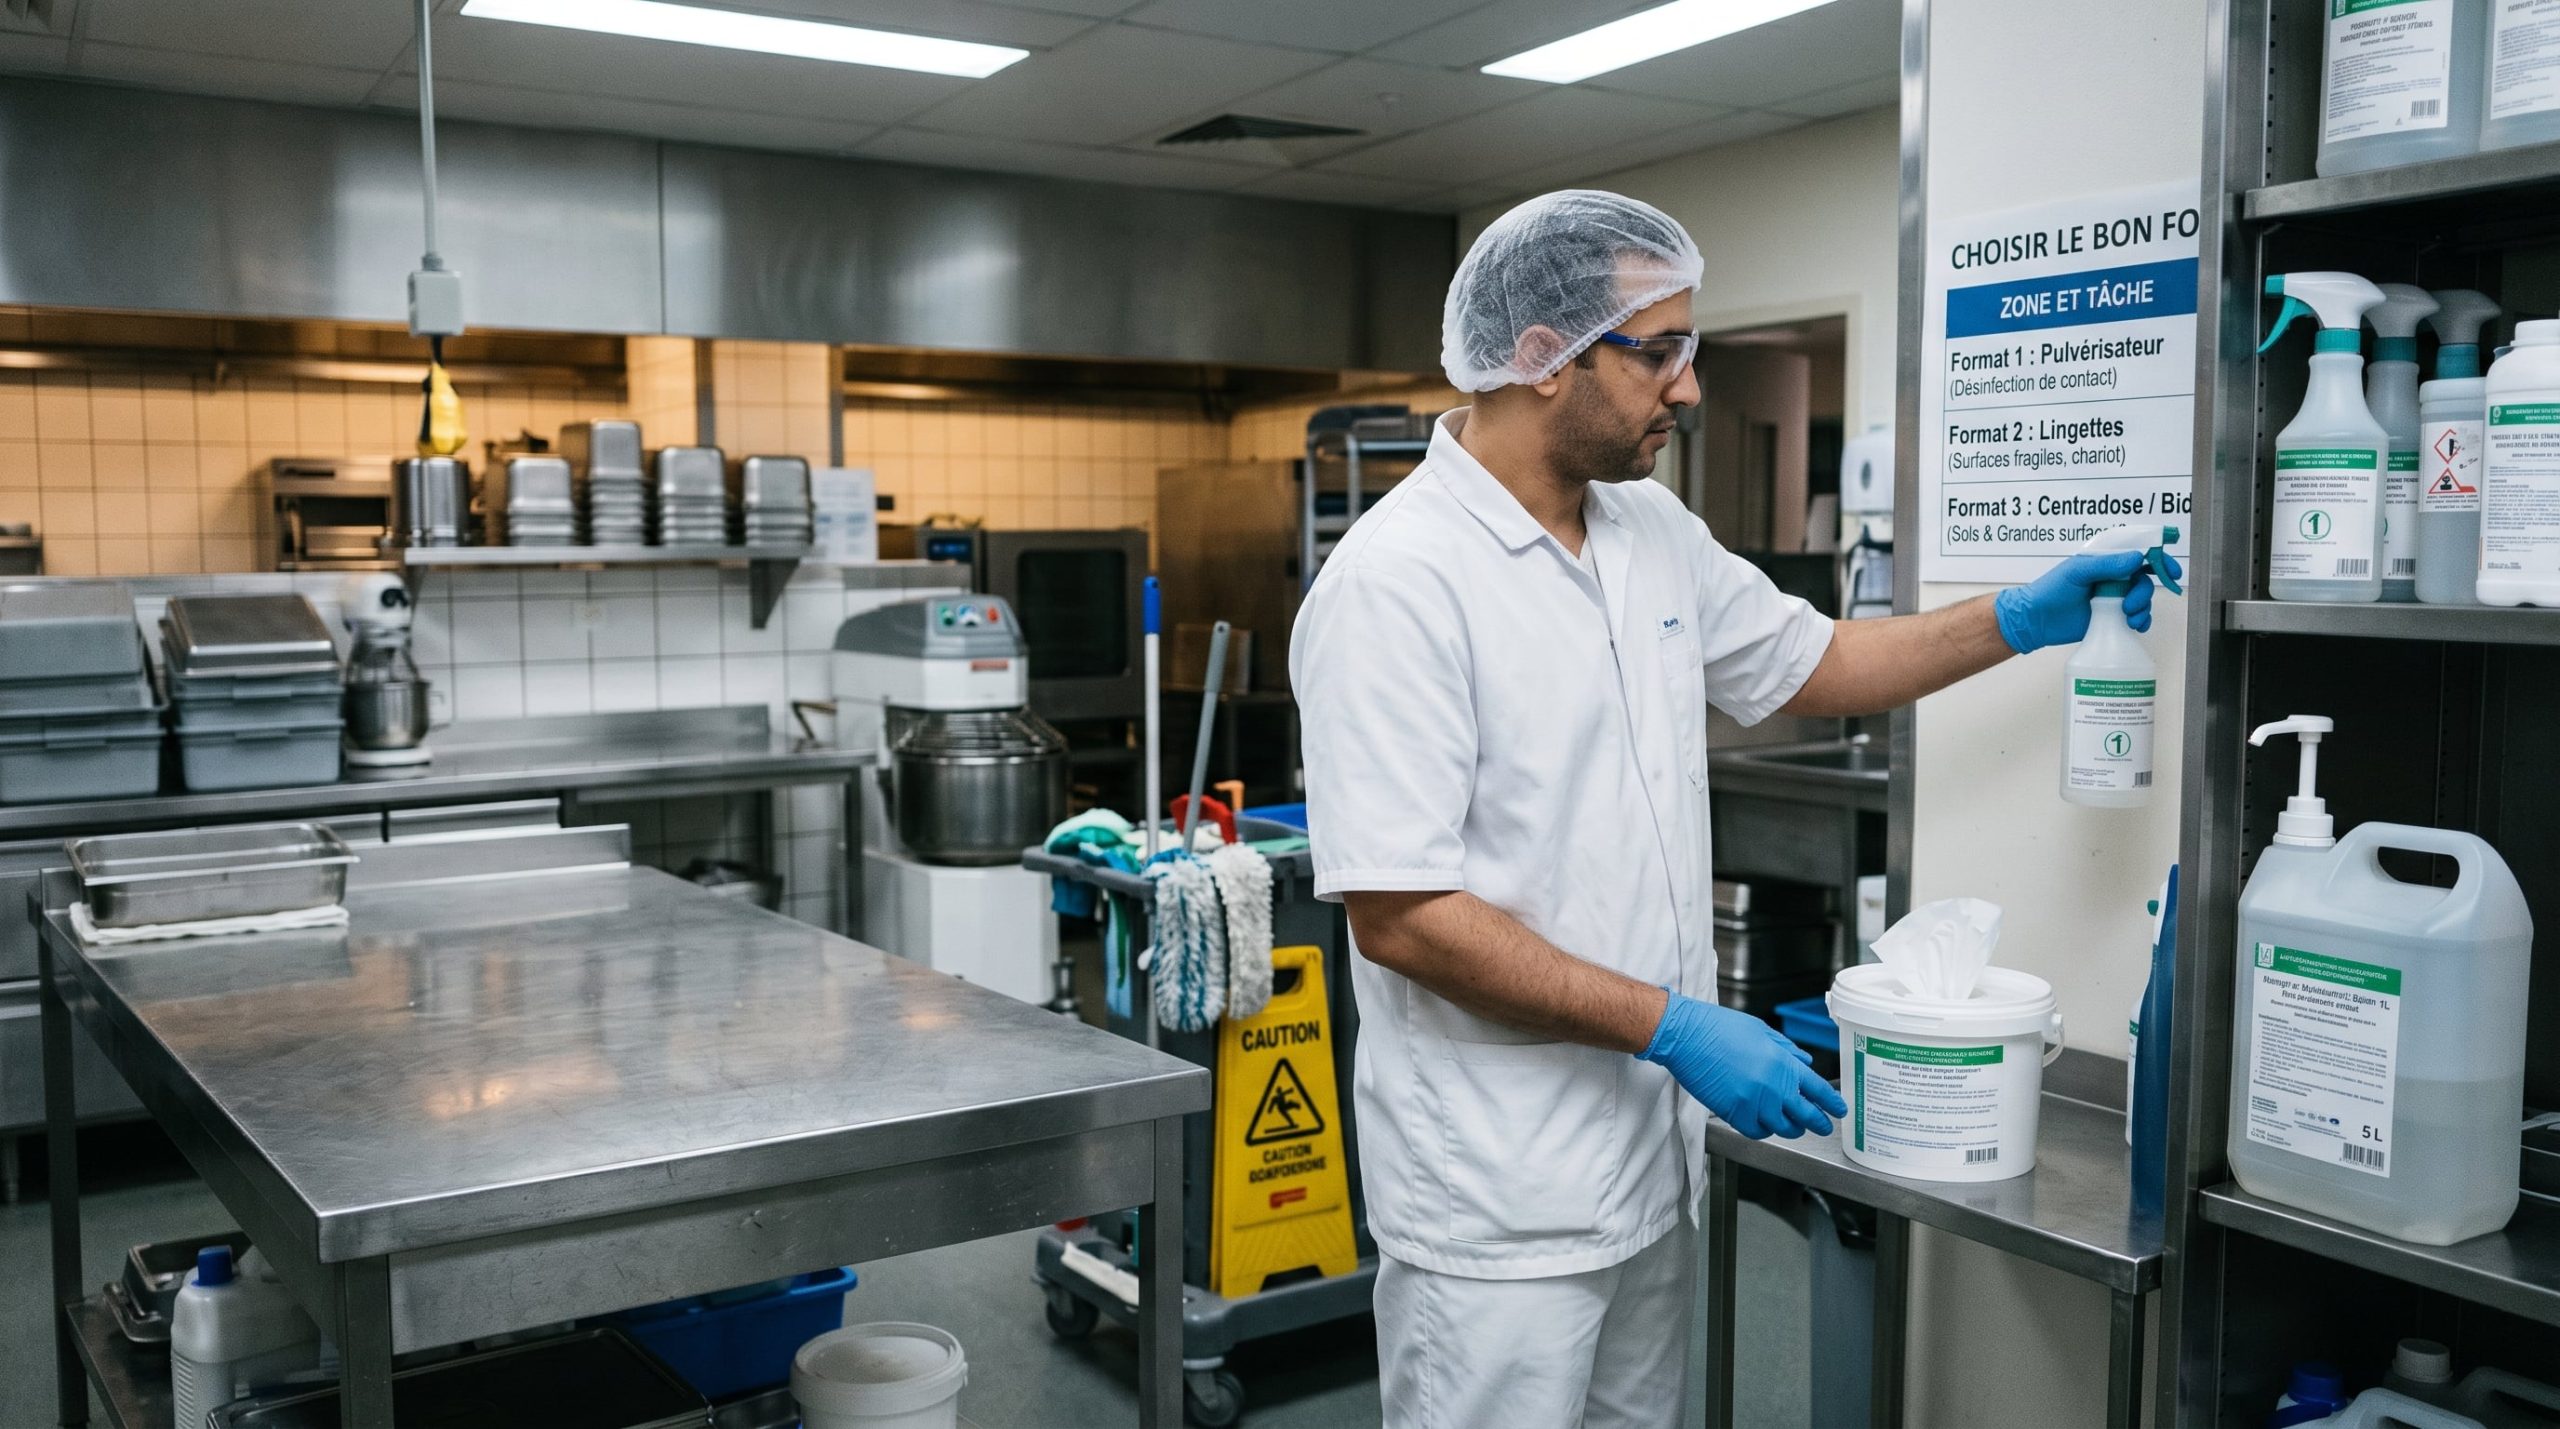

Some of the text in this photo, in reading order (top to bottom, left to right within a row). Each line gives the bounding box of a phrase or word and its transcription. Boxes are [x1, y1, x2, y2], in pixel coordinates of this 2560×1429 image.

[1952, 209, 2199, 269] CHOISIR LE BON FO
[2001, 280, 2153, 318] ZONE ET TÂCHE
[1952, 337, 2164, 371] Format 1 : Pulvérisateur
[1950, 367, 2116, 400] (Désinfection de contact)
[1950, 418, 2123, 444] Format 2 : Lingettes
[1949, 443, 2125, 472] (Surfaces fragiles, chariot)
[1949, 492, 2192, 516] Format 3 : Centradose / Bid
[1948, 525, 1979, 545] (Sols
[1984, 525, 1992, 541] &
[1998, 525, 2054, 541] Grandes
[2308, 513, 2320, 534] 1
[1242, 1020, 1320, 1052] CAUTION
[2362, 1125, 2382, 1142] 5 L
